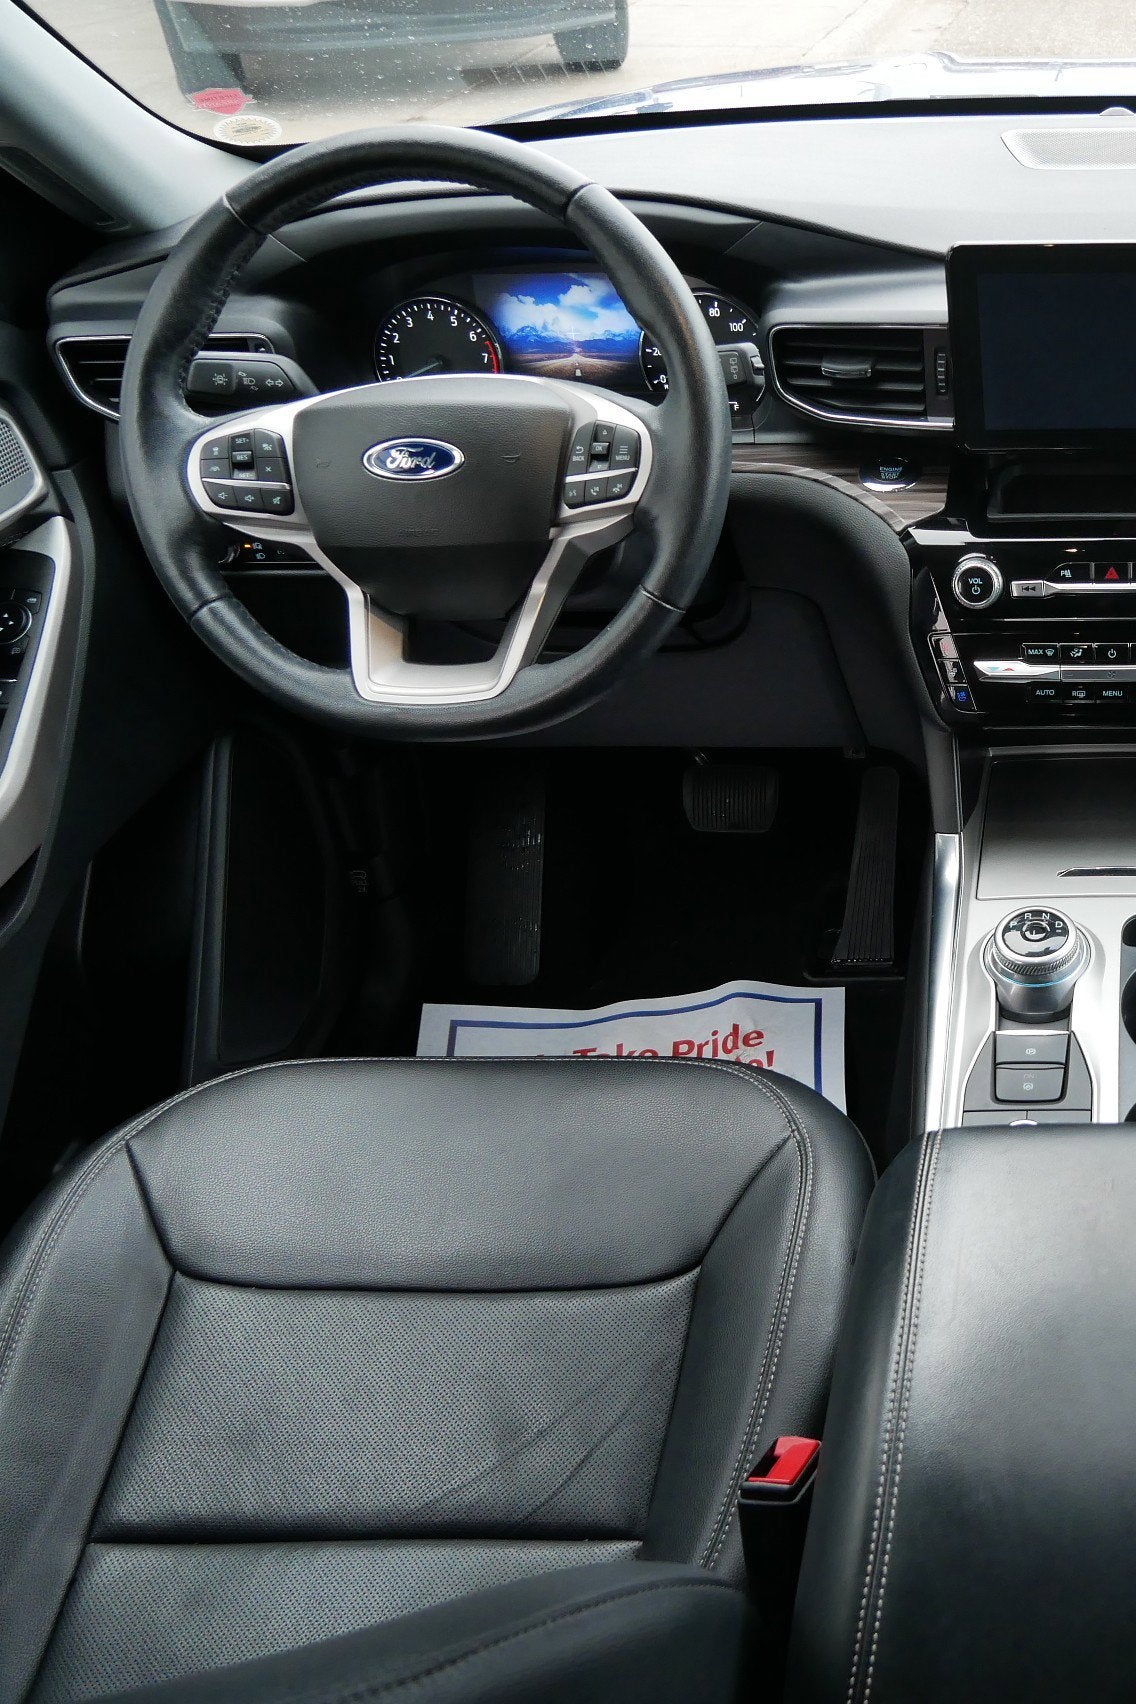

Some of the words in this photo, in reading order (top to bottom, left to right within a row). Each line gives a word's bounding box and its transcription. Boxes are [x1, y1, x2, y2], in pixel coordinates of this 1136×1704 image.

[427, 311, 434, 320] 4
[709, 308, 720, 317] 80
[405, 317, 413, 327] 3
[450, 316, 457, 326] 5
[729, 323, 743, 331] 100
[393, 333, 400, 343] 2
[470, 331, 476, 341] 6
[389, 355, 394, 365] 1
[482, 353, 488, 363] 7
[386, 447, 437, 469] Ford
[968, 577, 983, 585] VOL
[1024, 912, 1033, 920] R
[1042, 912, 1051, 920] N
[1010, 921, 1019, 929] P
[672, 1023, 765, 1060] Pride
